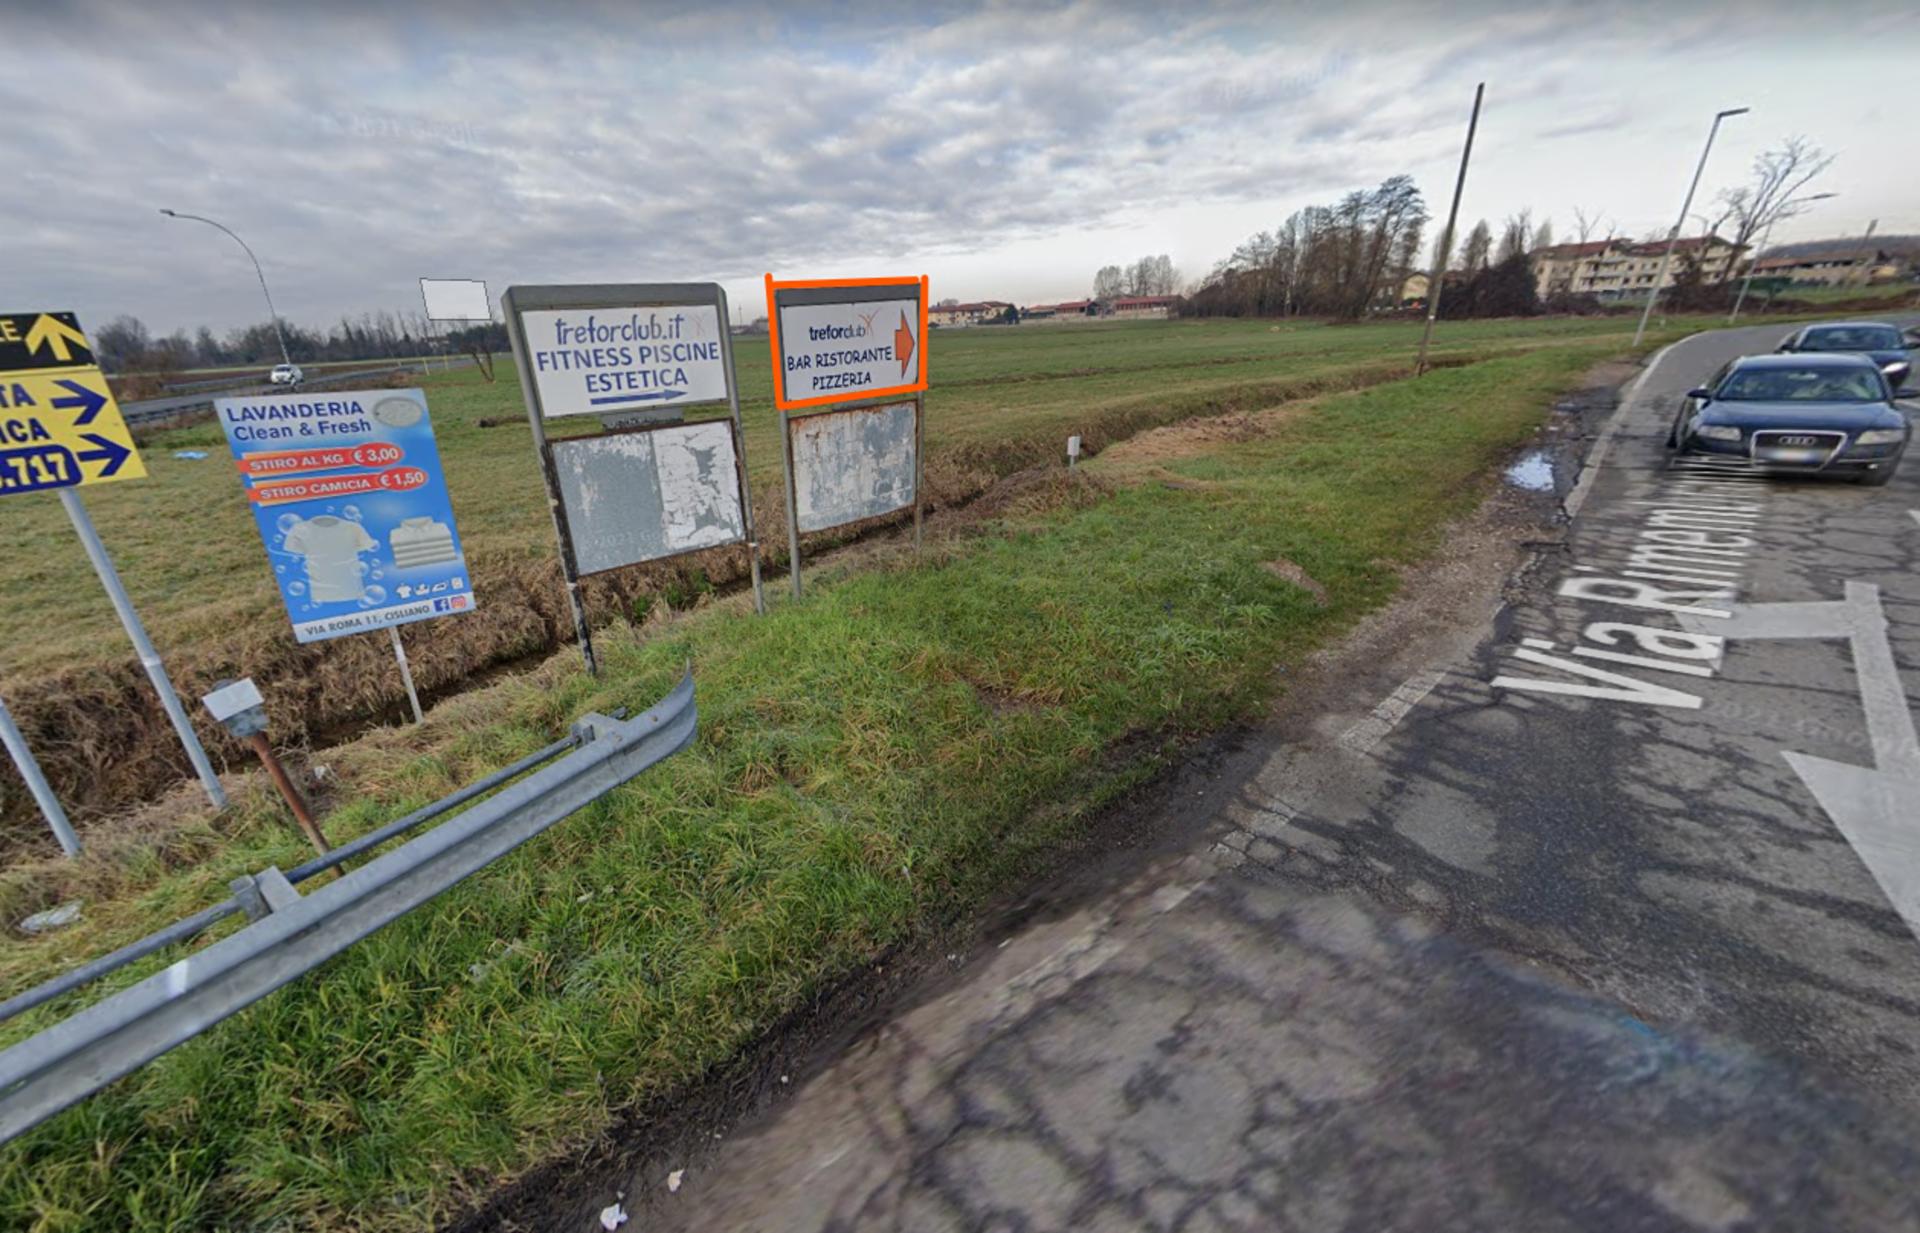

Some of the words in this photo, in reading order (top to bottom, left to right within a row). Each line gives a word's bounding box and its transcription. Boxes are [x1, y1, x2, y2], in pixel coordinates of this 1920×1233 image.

[0, 319, 22, 342] E
[555, 313, 685, 345] treforclub.it
[809, 324, 866, 341] treforclub
[536, 346, 633, 372] FITNESS
[640, 341, 720, 365] PISCINE
[787, 355, 812, 371] BAR
[816, 346, 892, 368] RISTORANTE
[585, 367, 688, 393] ESTETICA
[812, 371, 872, 390] PIZZERIA
[226, 401, 364, 422] LAVANDERIA
[234, 426, 293, 441] Clean
[300, 422, 314, 436] &
[318, 418, 372, 435] Fresh
[0, 452, 70, 488] .717
[250, 457, 298, 471] STIRO
[302, 454, 320, 466] AL
[322, 453, 344, 464] KG
[367, 448, 399, 462] 3,00
[260, 486, 307, 500] STIRO
[311, 479, 371, 493] CAMICIA
[394, 471, 425, 487] 1,50
[305, 625, 326, 636] VIA
[328, 619, 362, 631] ROMA
[384, 604, 430, 621] CISLIANO
